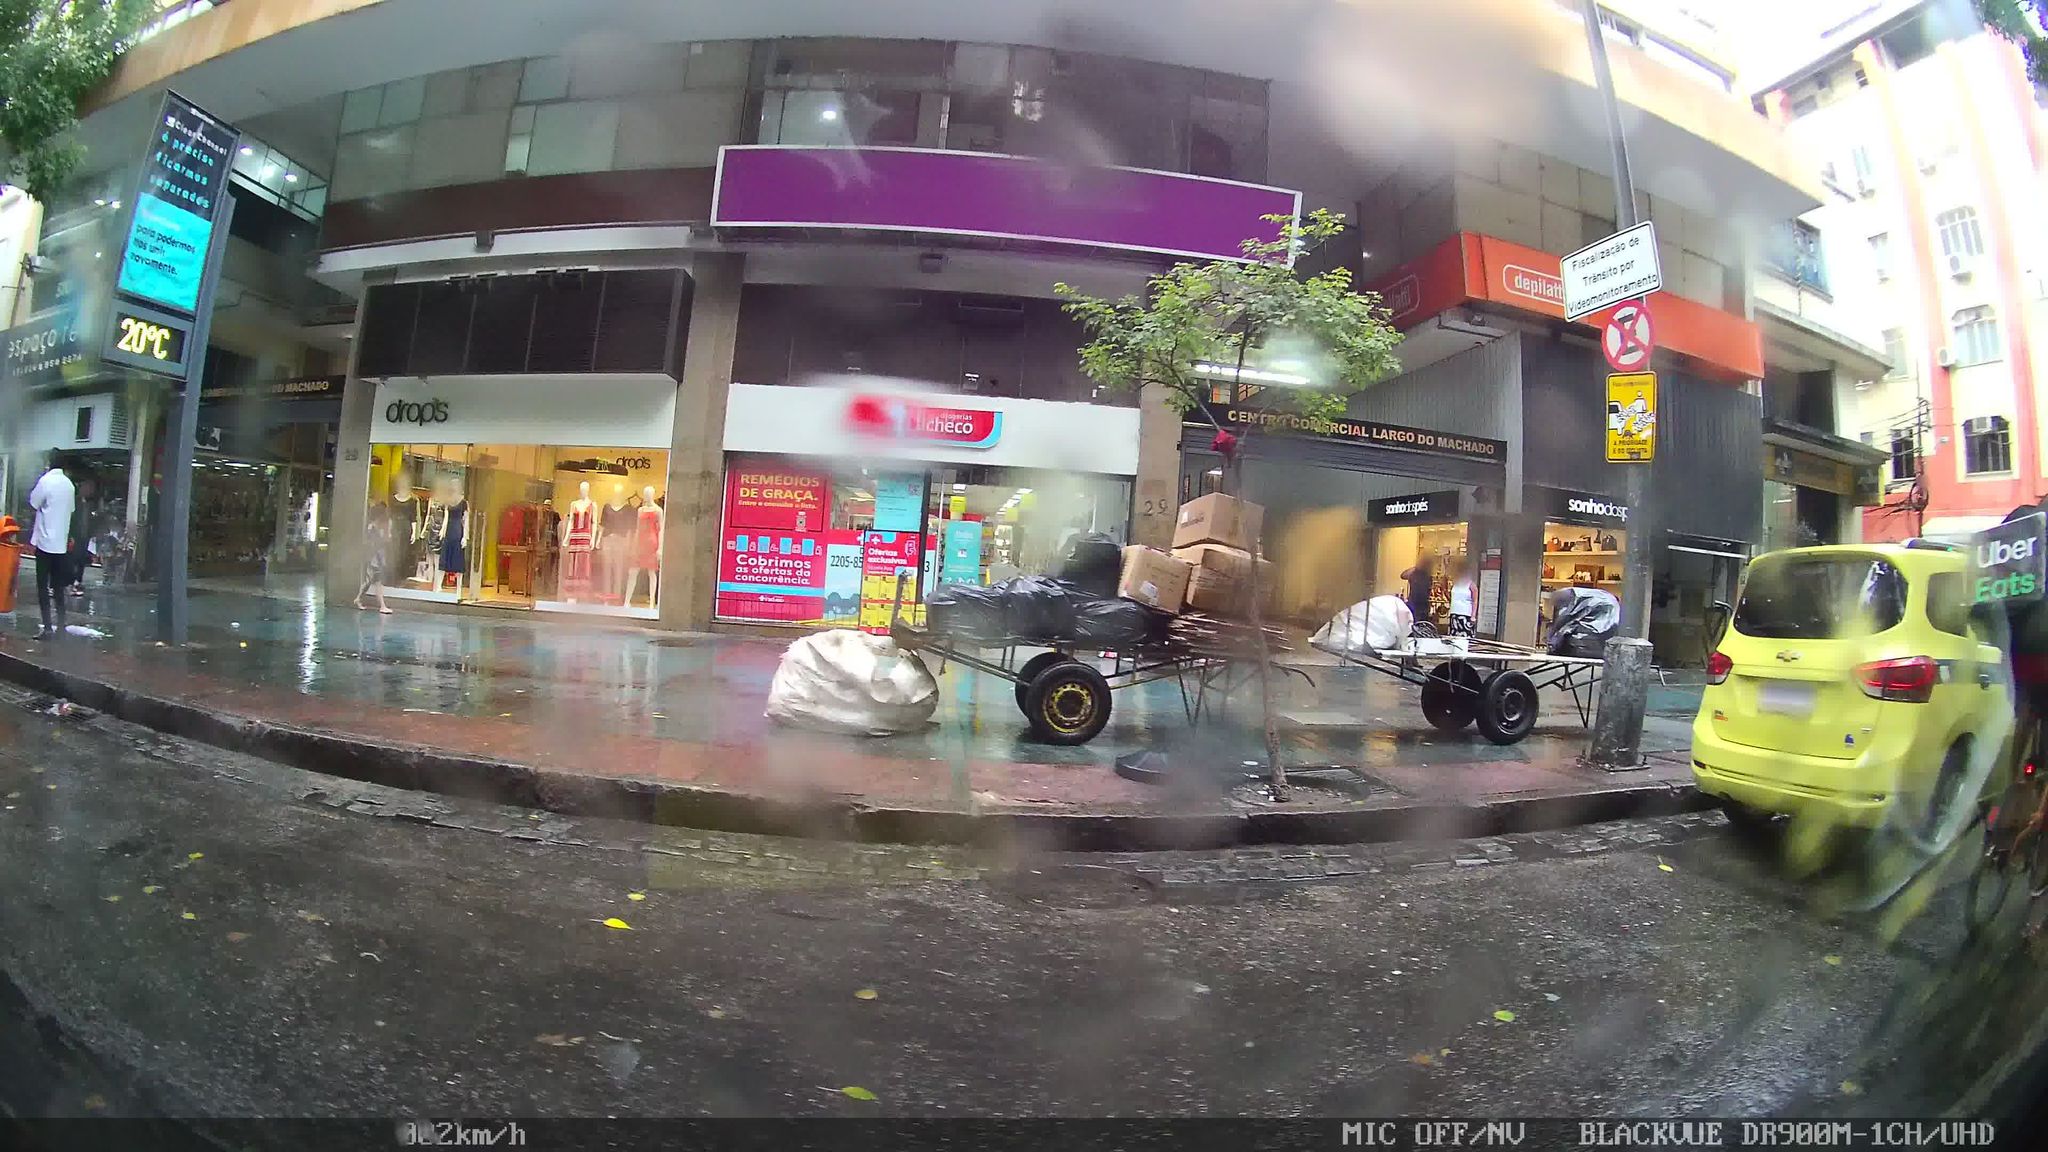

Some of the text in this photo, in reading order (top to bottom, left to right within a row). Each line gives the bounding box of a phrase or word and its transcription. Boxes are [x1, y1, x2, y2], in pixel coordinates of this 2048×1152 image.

[172, 139, 214, 167] preciso
[156, 151, 208, 185] ficarmos
[1628, 236, 1640, 248] de
[1582, 260, 1635, 287] Trânsito por
[1568, 274, 1658, 313] Videomonitoramento
[285, 381, 329, 393] MACHADO
[920, 416, 974, 434] checo
[1372, 427, 1415, 443] LARGO
[1417, 434, 1435, 446] DO
[1438, 437, 1494, 454] MACHADO
[739, 488, 819, 502] DE GRAÇA.
[1143, 499, 1168, 516] 29
[867, 547, 898, 557] Ofertas
[867, 556, 908, 565] exclusivas
[1977, 537, 2038, 568] Uber
[736, 554, 812, 569] Cobrimos
[734, 574, 811, 585] concorrência.
[735, 566, 811, 577] as ofertas da
[1975, 572, 2036, 603] Eats
